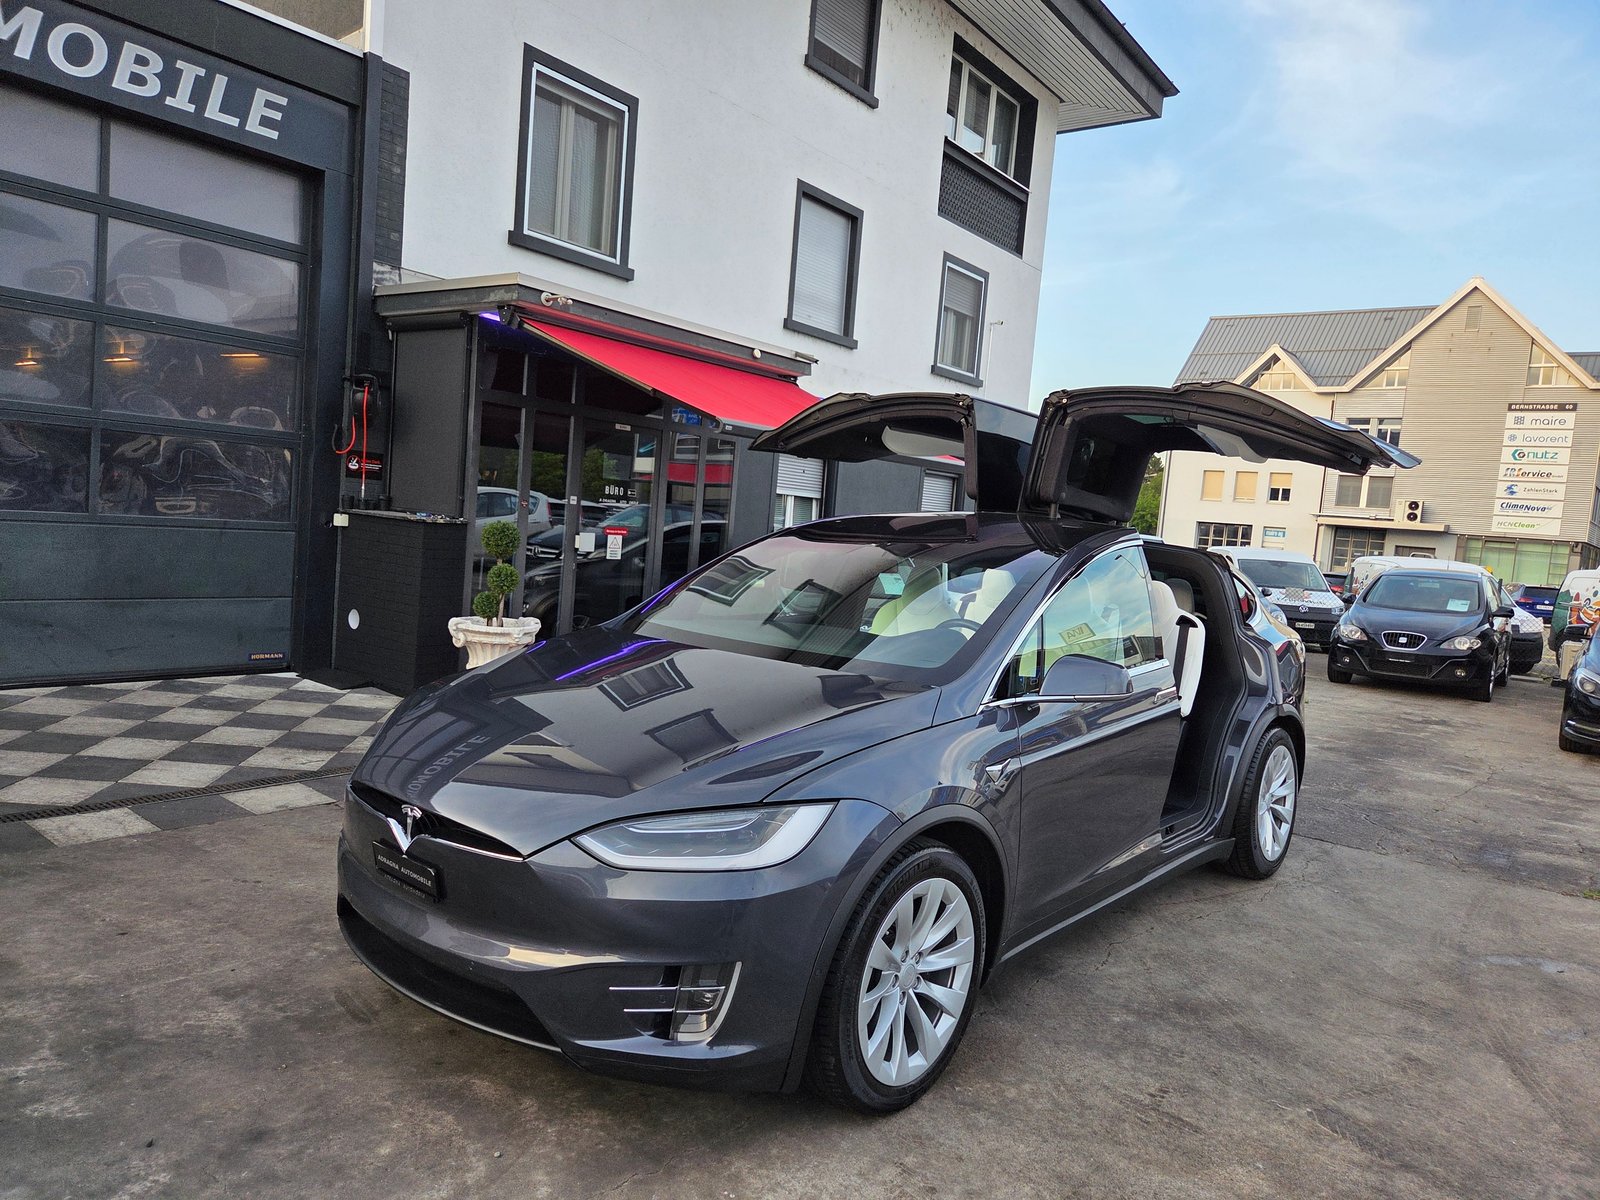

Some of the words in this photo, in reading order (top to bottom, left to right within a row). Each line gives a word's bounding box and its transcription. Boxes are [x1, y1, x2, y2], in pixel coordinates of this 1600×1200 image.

[1530, 416, 1567, 426] maire
[1522, 433, 1569, 443] lavorent
[605, 484, 624, 496] BÜRO
[1500, 501, 1547, 513] ClimaNova
[1496, 521, 1536, 529] HCNClean
[401, 866, 432, 887] AUTOMOBILE
